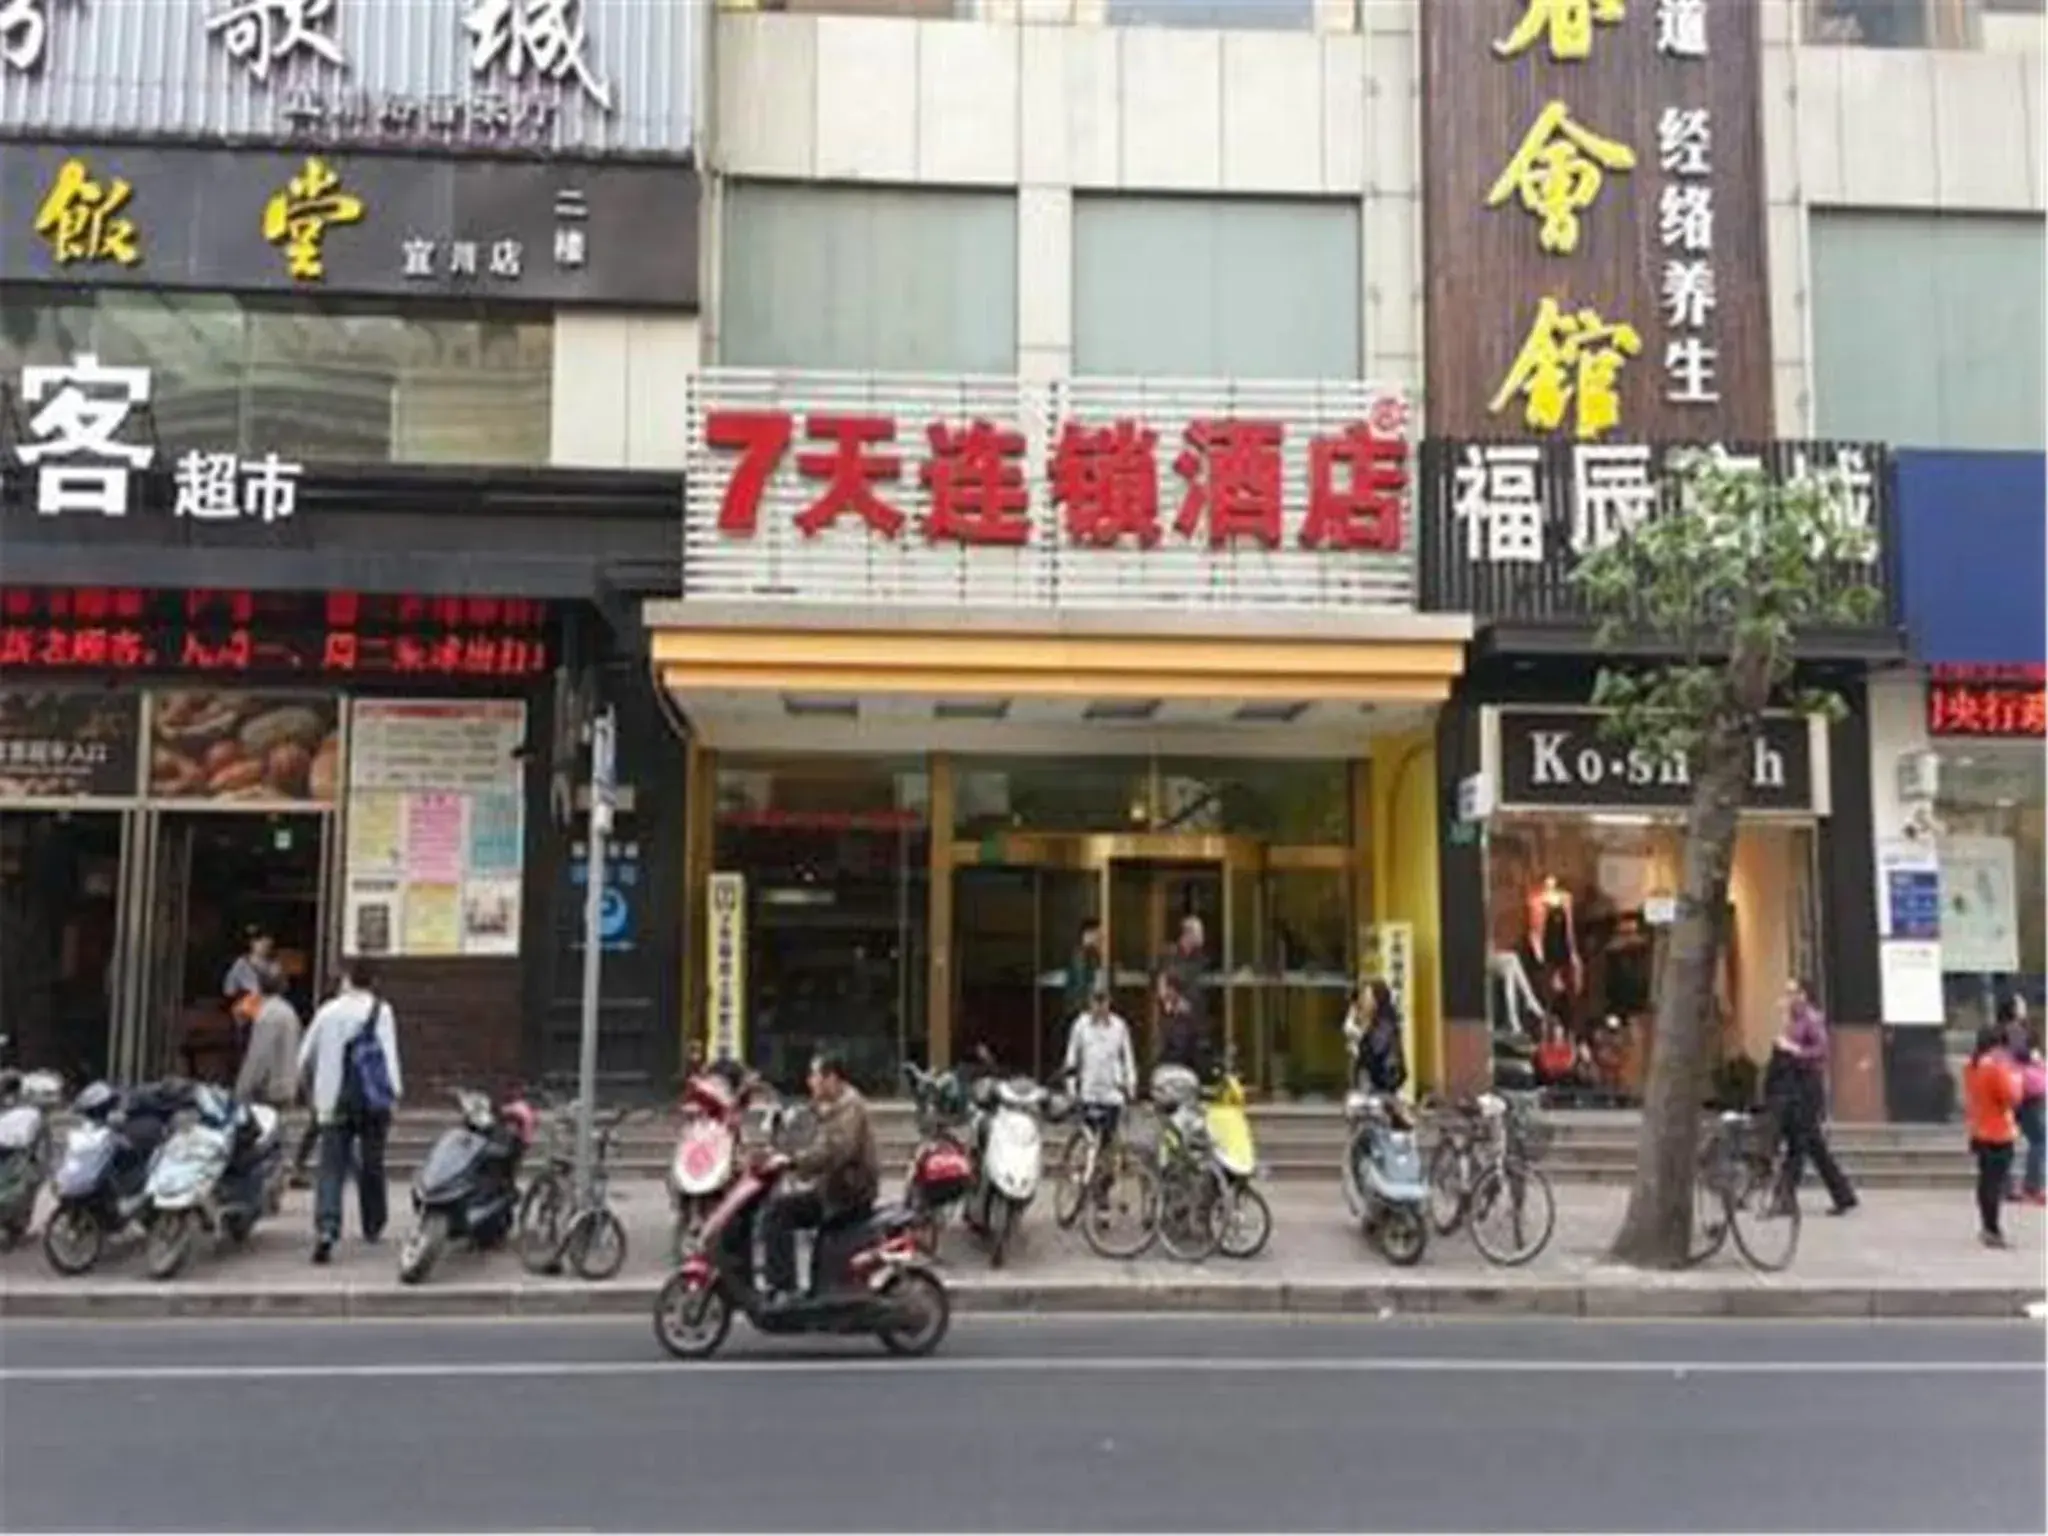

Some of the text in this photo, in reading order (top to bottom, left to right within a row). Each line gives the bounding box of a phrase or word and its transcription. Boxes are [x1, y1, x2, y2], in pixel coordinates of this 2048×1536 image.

[1657, 107, 1721, 405] 经络养生
[173, 448, 304, 523] 超市
[705, 411, 1410, 552] 7天连锁酒店
